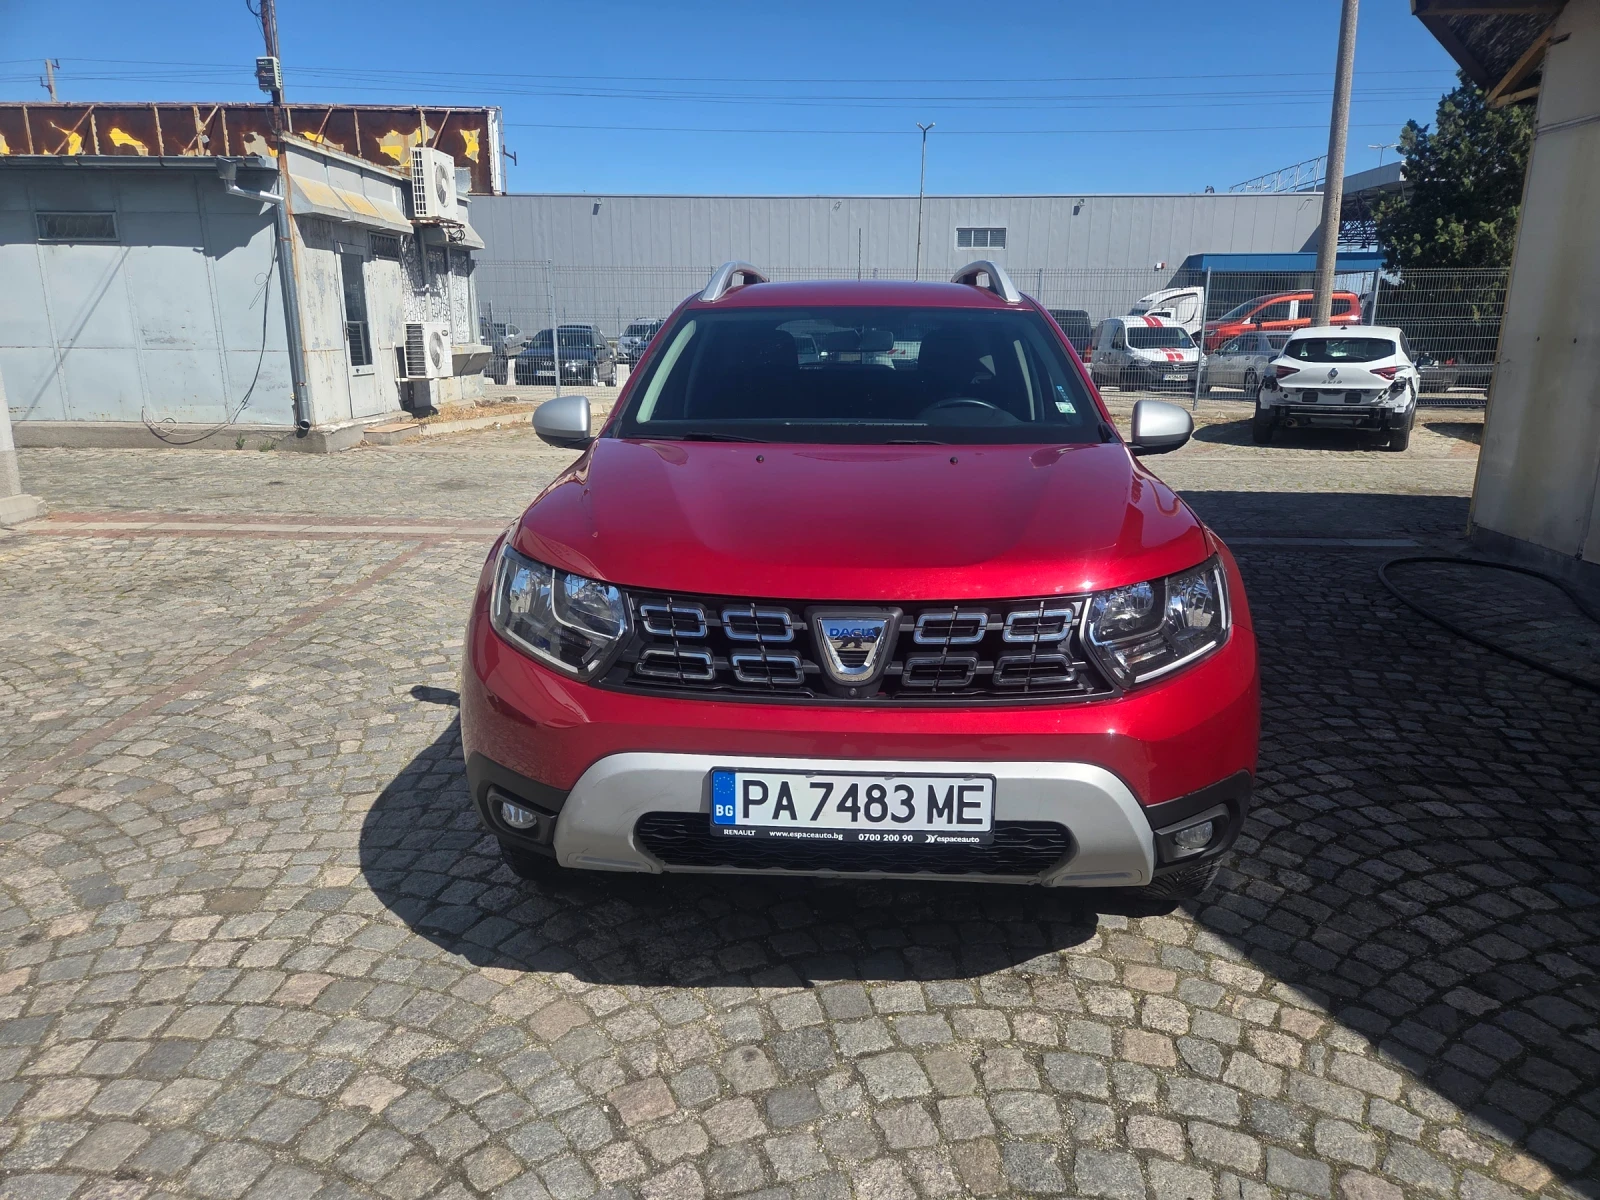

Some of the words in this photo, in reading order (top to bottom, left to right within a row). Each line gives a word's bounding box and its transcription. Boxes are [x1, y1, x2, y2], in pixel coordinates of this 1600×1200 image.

[829, 628, 877, 637] DACIA
[742, 779, 798, 821] PA
[809, 782, 916, 824] 7483
[927, 784, 985, 825] ME
[715, 804, 734, 817] BG
[769, 830, 843, 840] www.espaceauto.bg
[858, 833, 881, 842] 0700
[883, 834, 900, 842] 200
[902, 834, 914, 842] 90
